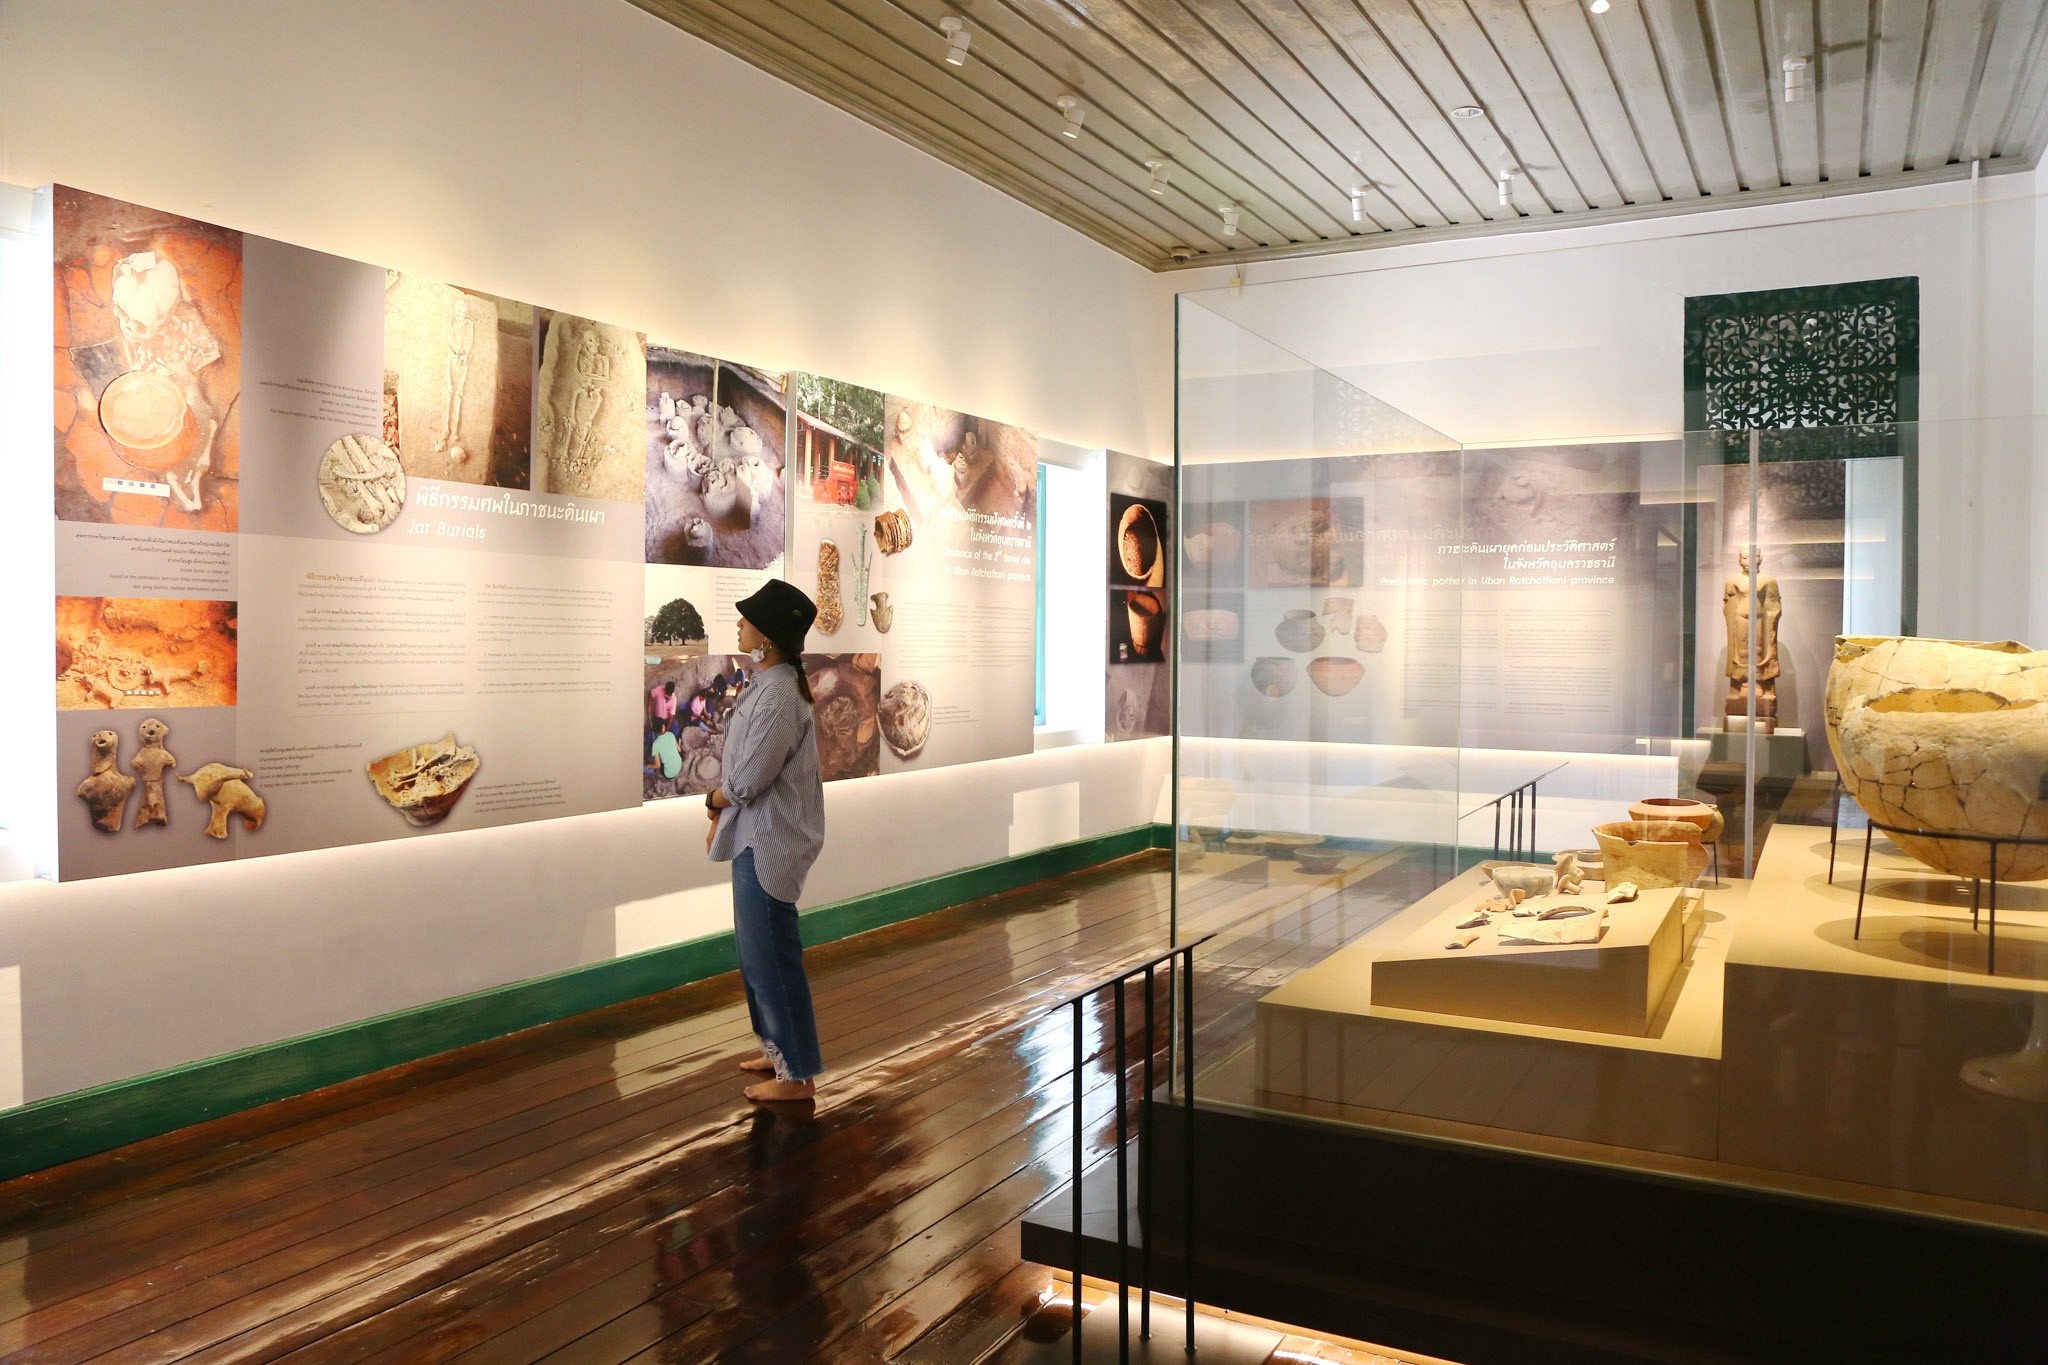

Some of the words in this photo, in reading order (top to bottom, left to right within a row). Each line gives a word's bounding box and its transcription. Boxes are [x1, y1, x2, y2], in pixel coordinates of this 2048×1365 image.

[415, 485, 606, 525] พิธีกรรมศพในภาชนะดินเผา
[407, 519, 431, 534] Jar
[438, 522, 486, 539] Burials
[974, 550, 981, 561] of
[982, 551, 992, 561] the
[1503, 556, 1616, 572] ในจังหวัดอุบลราชธานี
[953, 565, 969, 576] Ubon
[971, 567, 1006, 579] Ratchathani
[1468, 576, 1477, 585] in
[1481, 576, 1505, 585] Ubon
[1509, 575, 1567, 585] Ratchathani
[1570, 575, 1615, 587] province
